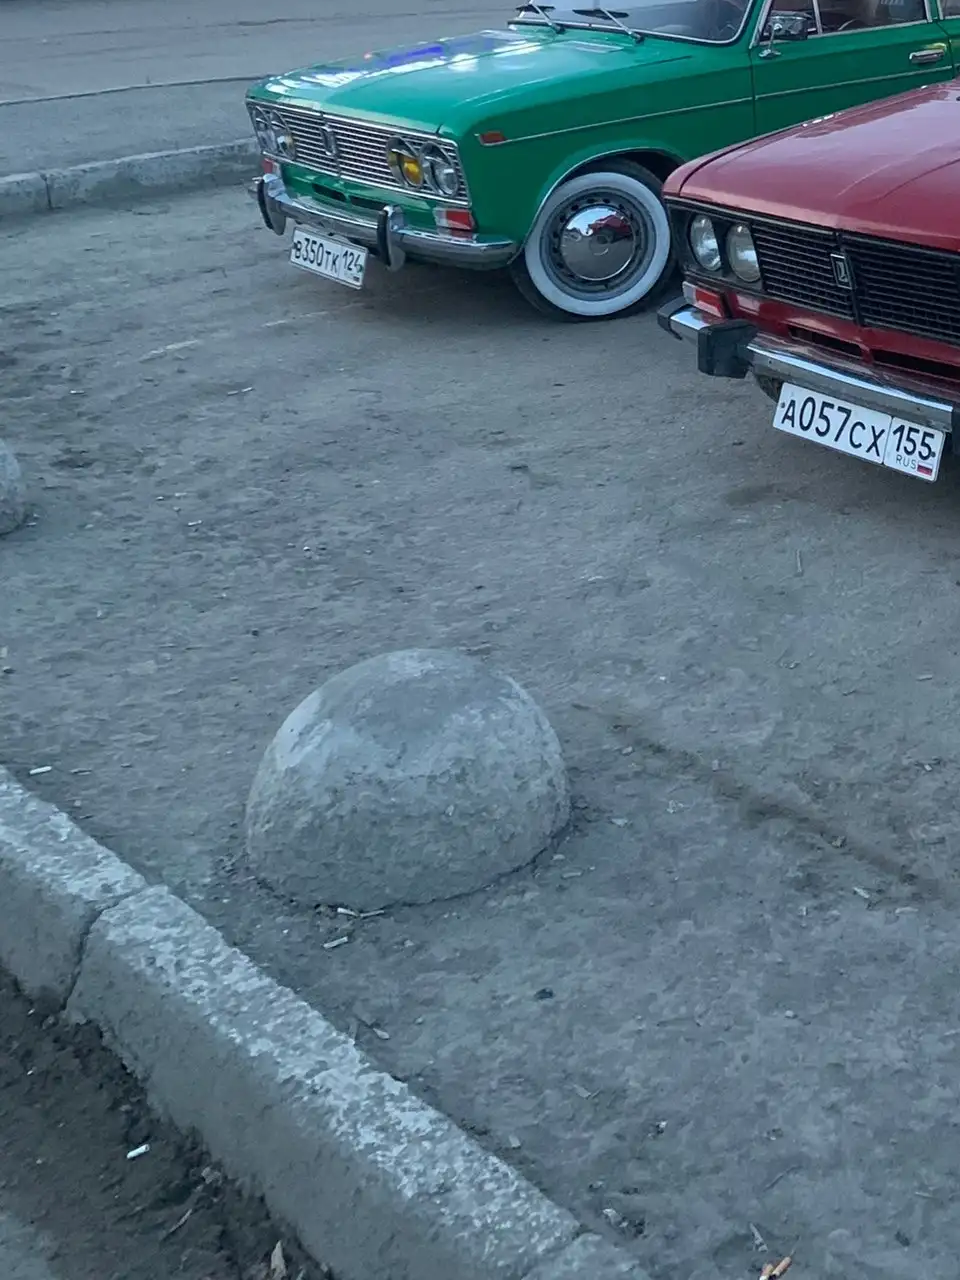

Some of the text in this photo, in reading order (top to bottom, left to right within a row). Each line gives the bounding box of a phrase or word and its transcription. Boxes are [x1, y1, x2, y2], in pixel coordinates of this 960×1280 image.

[781, 396, 935, 461] А057СХ 155
[896, 454, 917, 470] RUS
